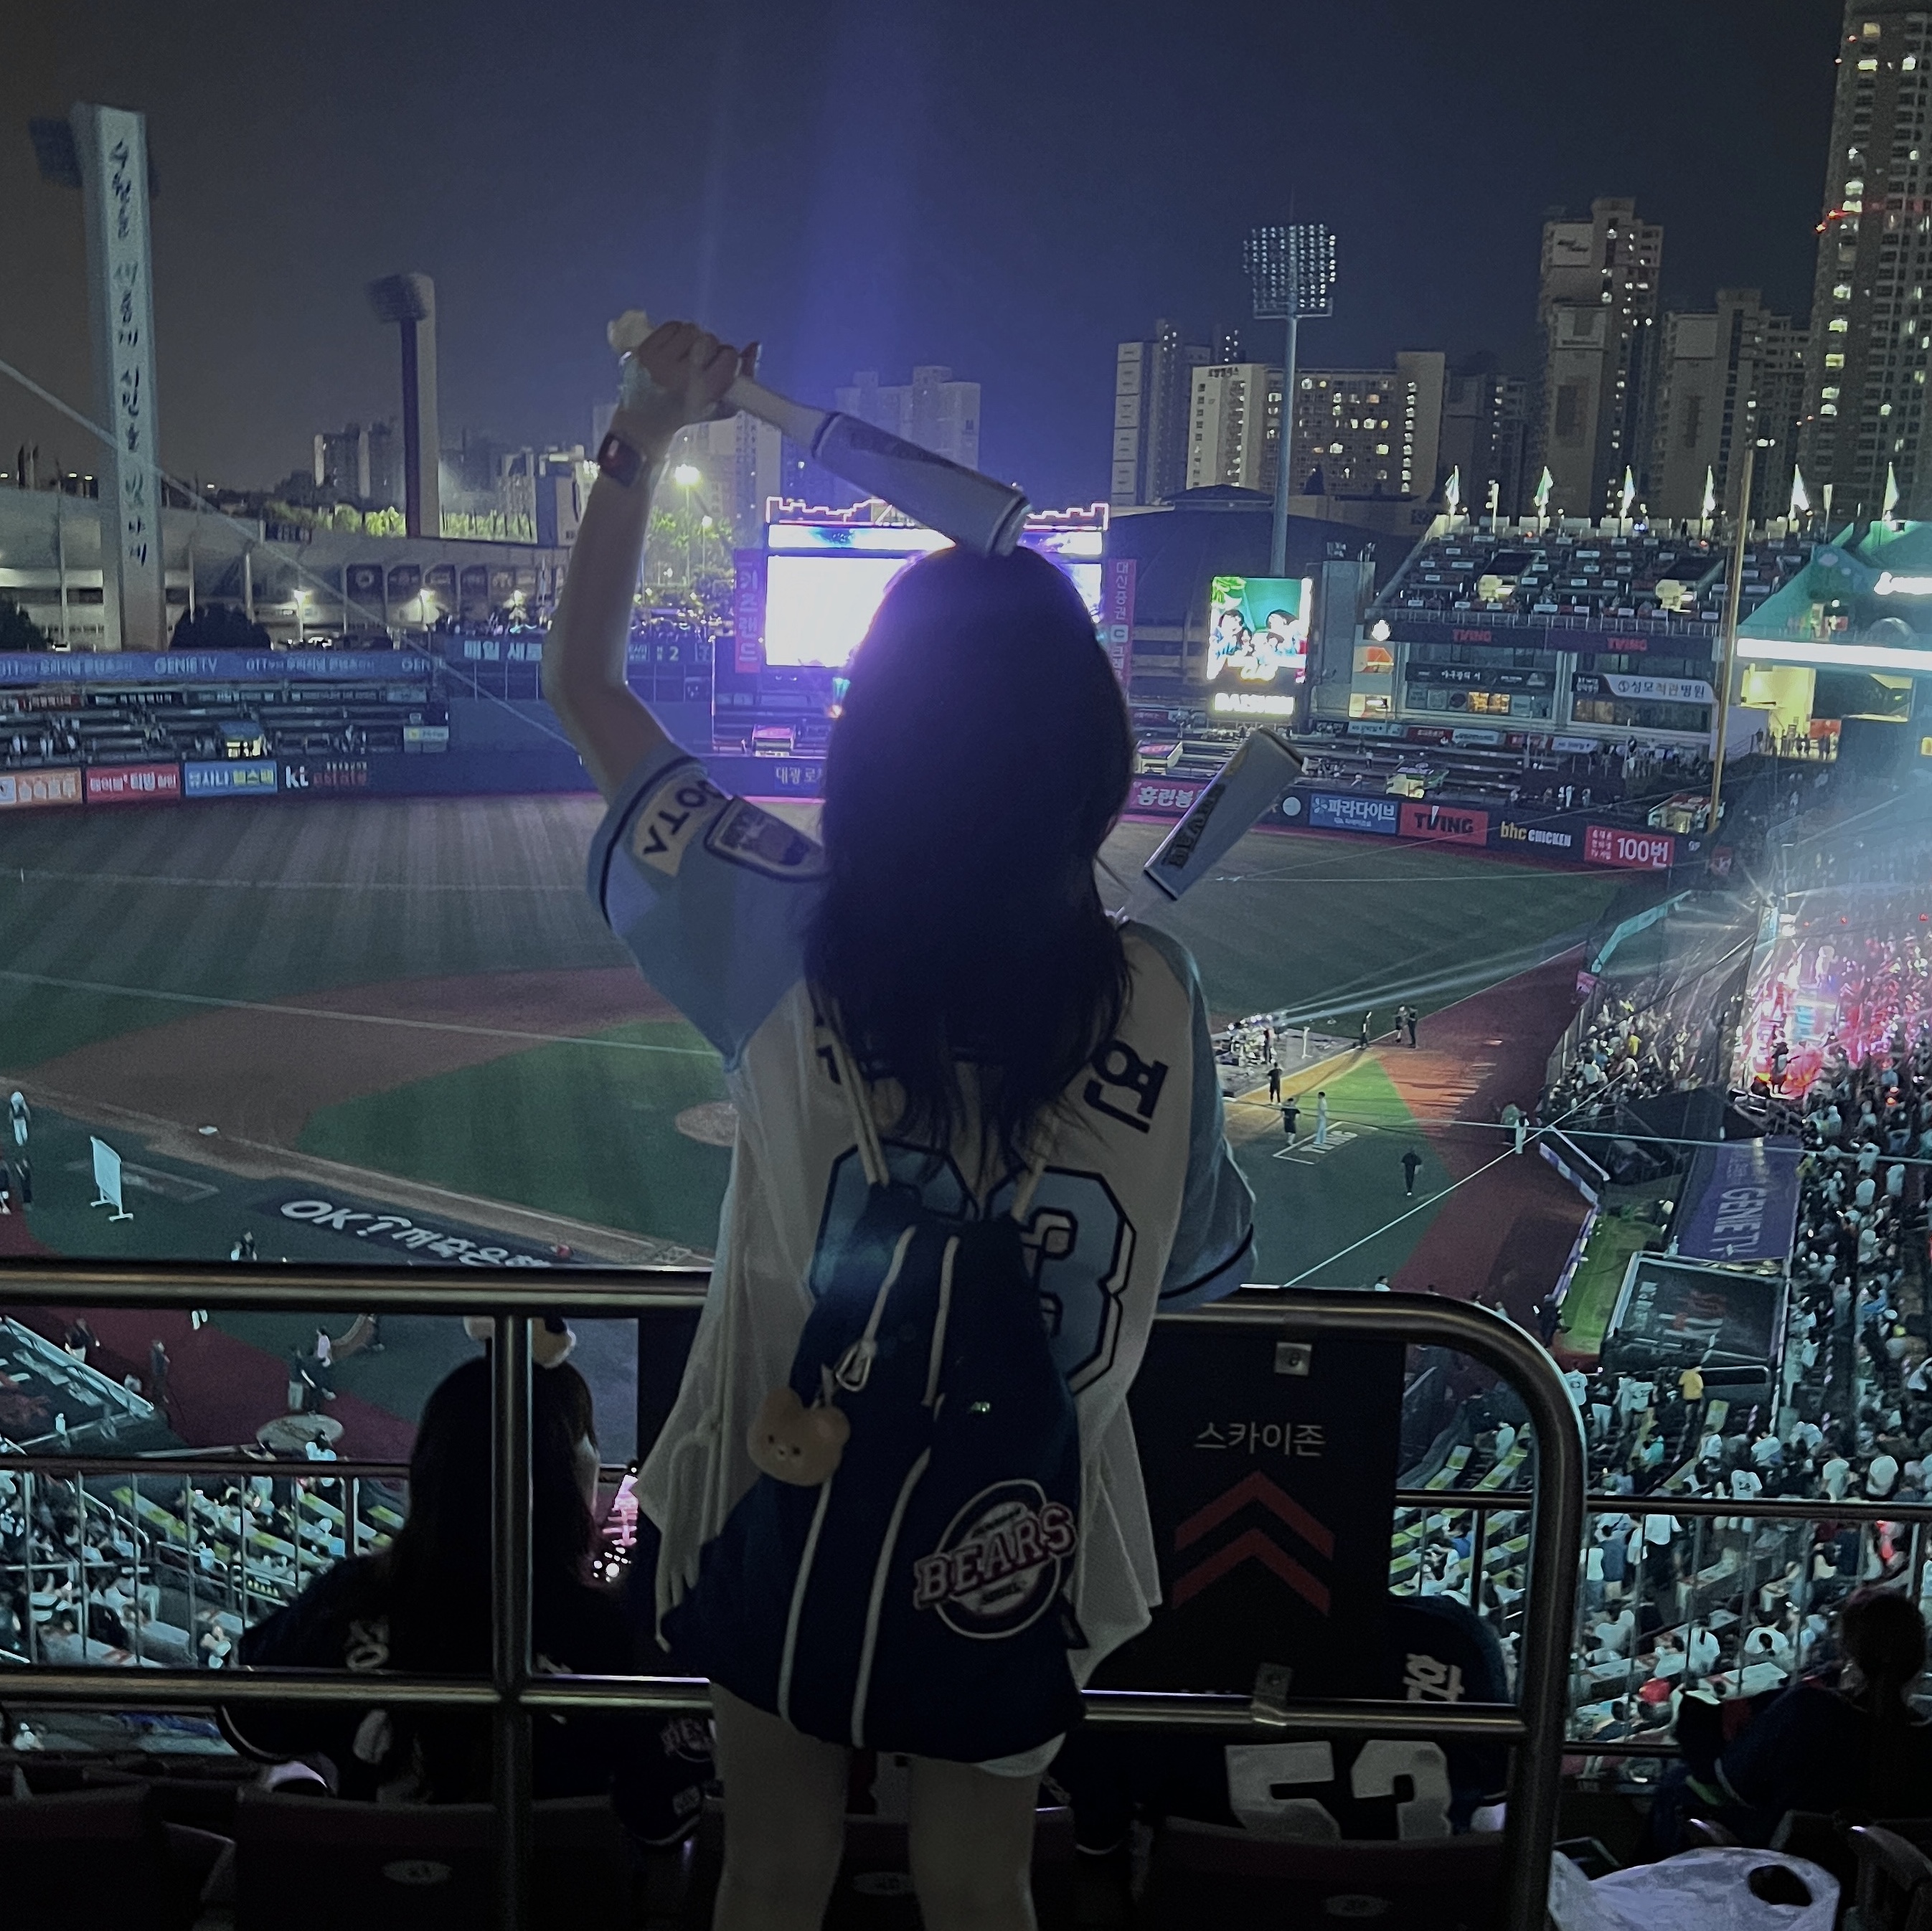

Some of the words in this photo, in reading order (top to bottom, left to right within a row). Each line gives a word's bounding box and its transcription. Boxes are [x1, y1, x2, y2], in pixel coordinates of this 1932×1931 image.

[1114, 561, 1129, 620] 대신증권
[1328, 798, 1395, 821] 파라다이브
[1414, 806, 1474, 834] TVING
[1501, 821, 1527, 841] bhc
[1528, 829, 1572, 847] CHICKEN
[1616, 837, 1669, 868] 100번
[1713, 1187, 1768, 1234] GENIE
[1194, 1421, 1326, 1458] 스카이존
[914, 1502, 1077, 1610] BEARS
